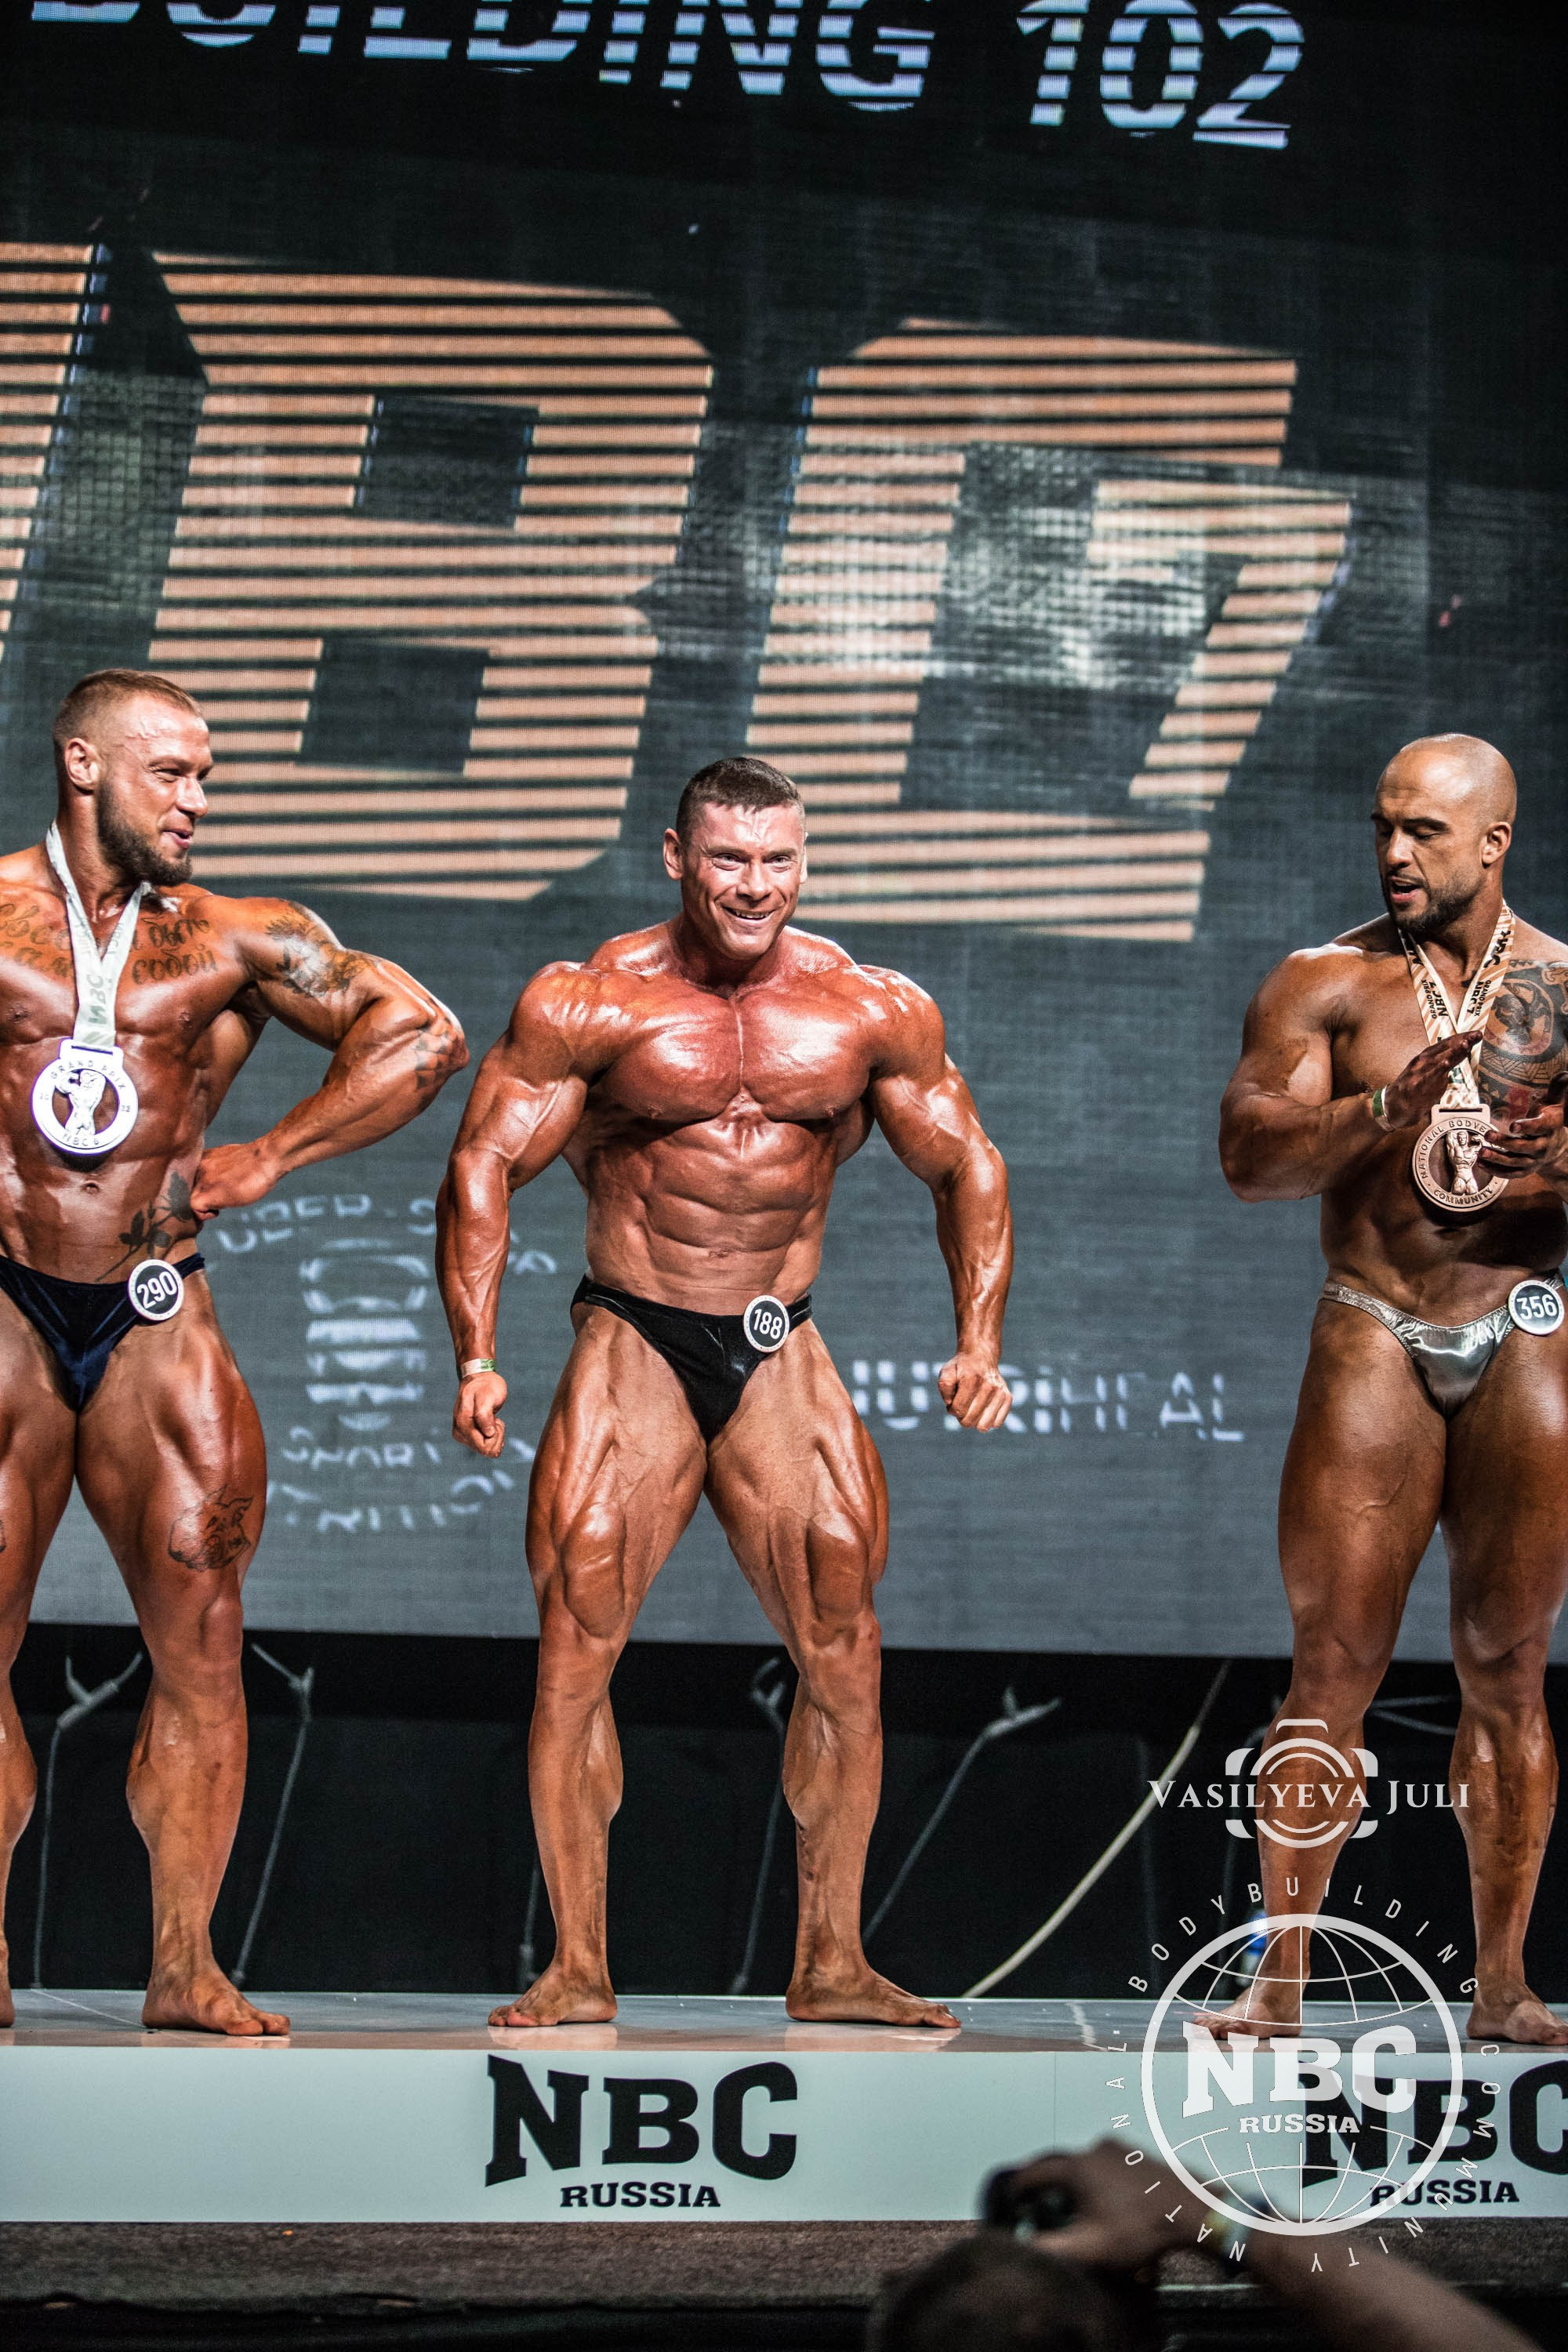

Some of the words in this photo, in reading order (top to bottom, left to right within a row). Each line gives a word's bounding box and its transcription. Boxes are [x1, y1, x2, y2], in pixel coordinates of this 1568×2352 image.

[1016, 0, 1305, 149] 102
[1418, 1126, 1444, 1179] NATIONAL
[1433, 1185, 1494, 1206] COMMUNITY
[136, 1271, 178, 1309] 290
[1516, 1294, 1558, 1320] 356
[753, 1308, 783, 1340] 188
[485, 2053, 798, 2187] NBC
[1298, 2059, 1568, 2189] NBC
[560, 2181, 721, 2208] RUSSIA
[1369, 2178, 1520, 2208] RUSSIA
